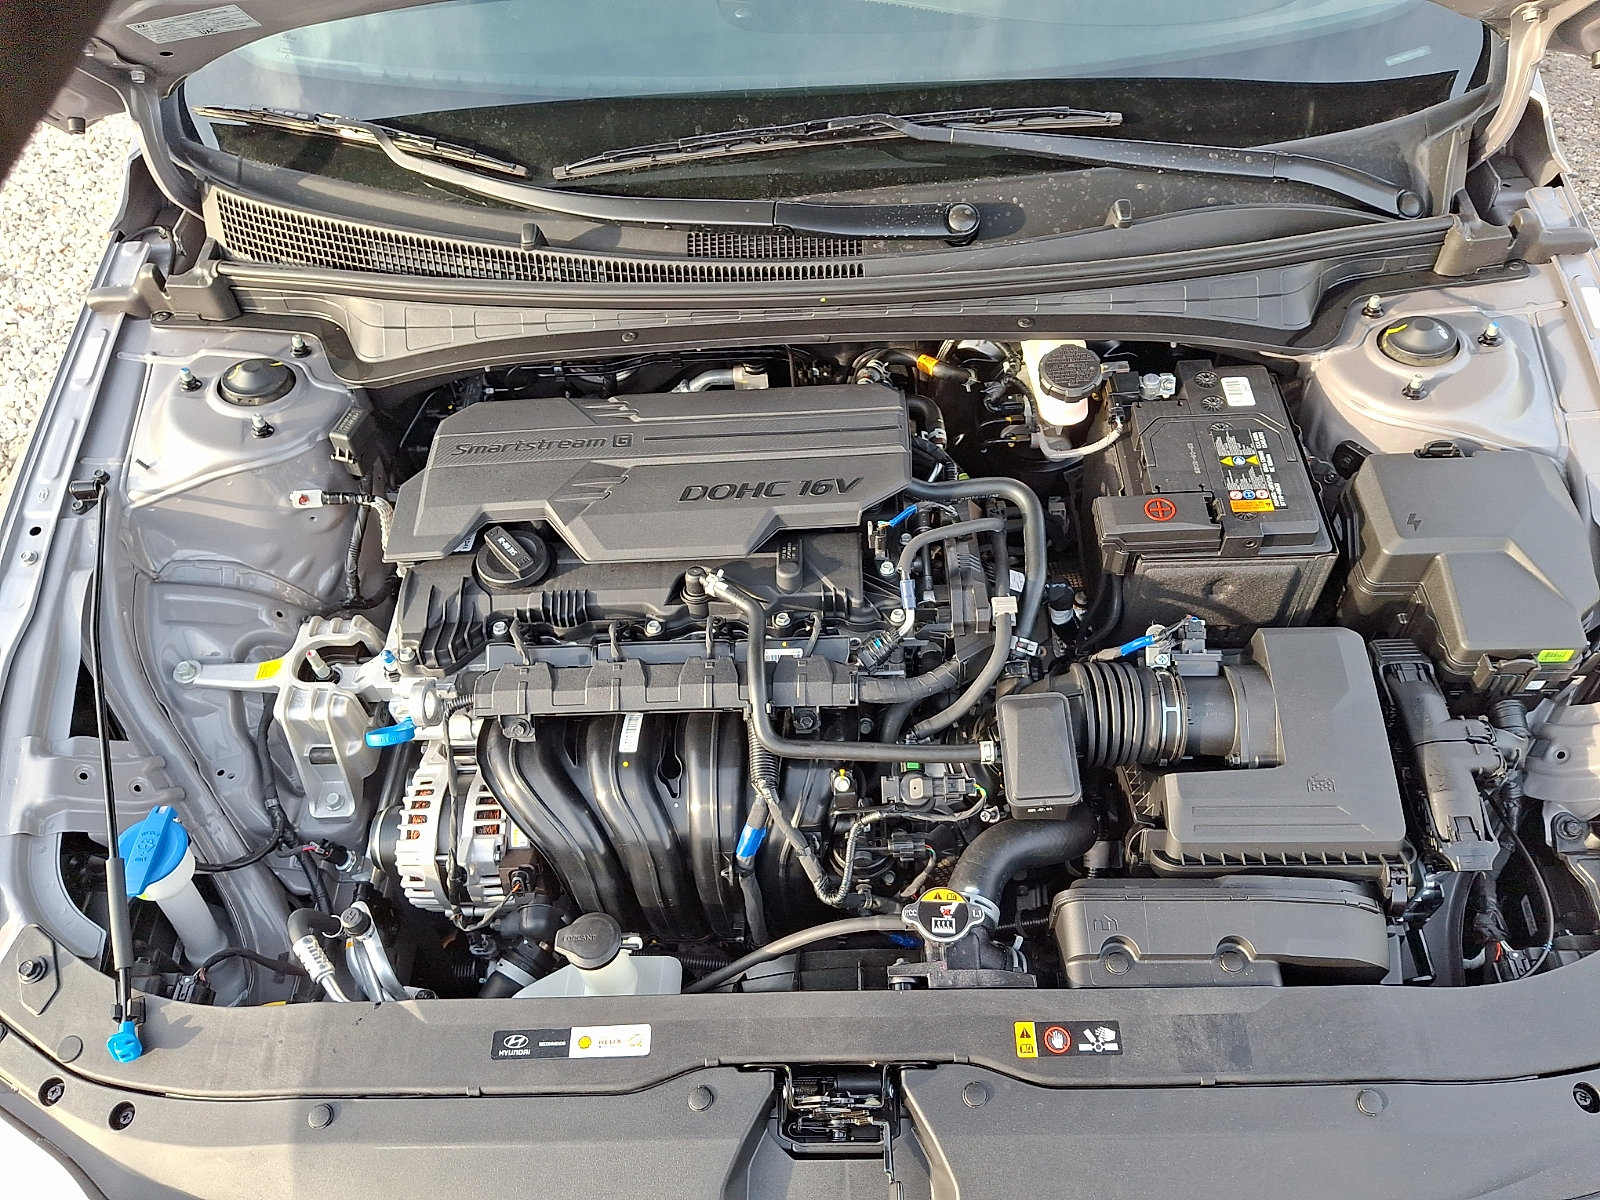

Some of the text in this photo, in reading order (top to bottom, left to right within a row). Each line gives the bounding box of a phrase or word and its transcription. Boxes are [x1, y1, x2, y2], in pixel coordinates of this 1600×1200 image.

[451, 437, 608, 456] Smartstream
[678, 476, 865, 502] DOHC 16V
[498, 1048, 531, 1056] HYUNDAI
